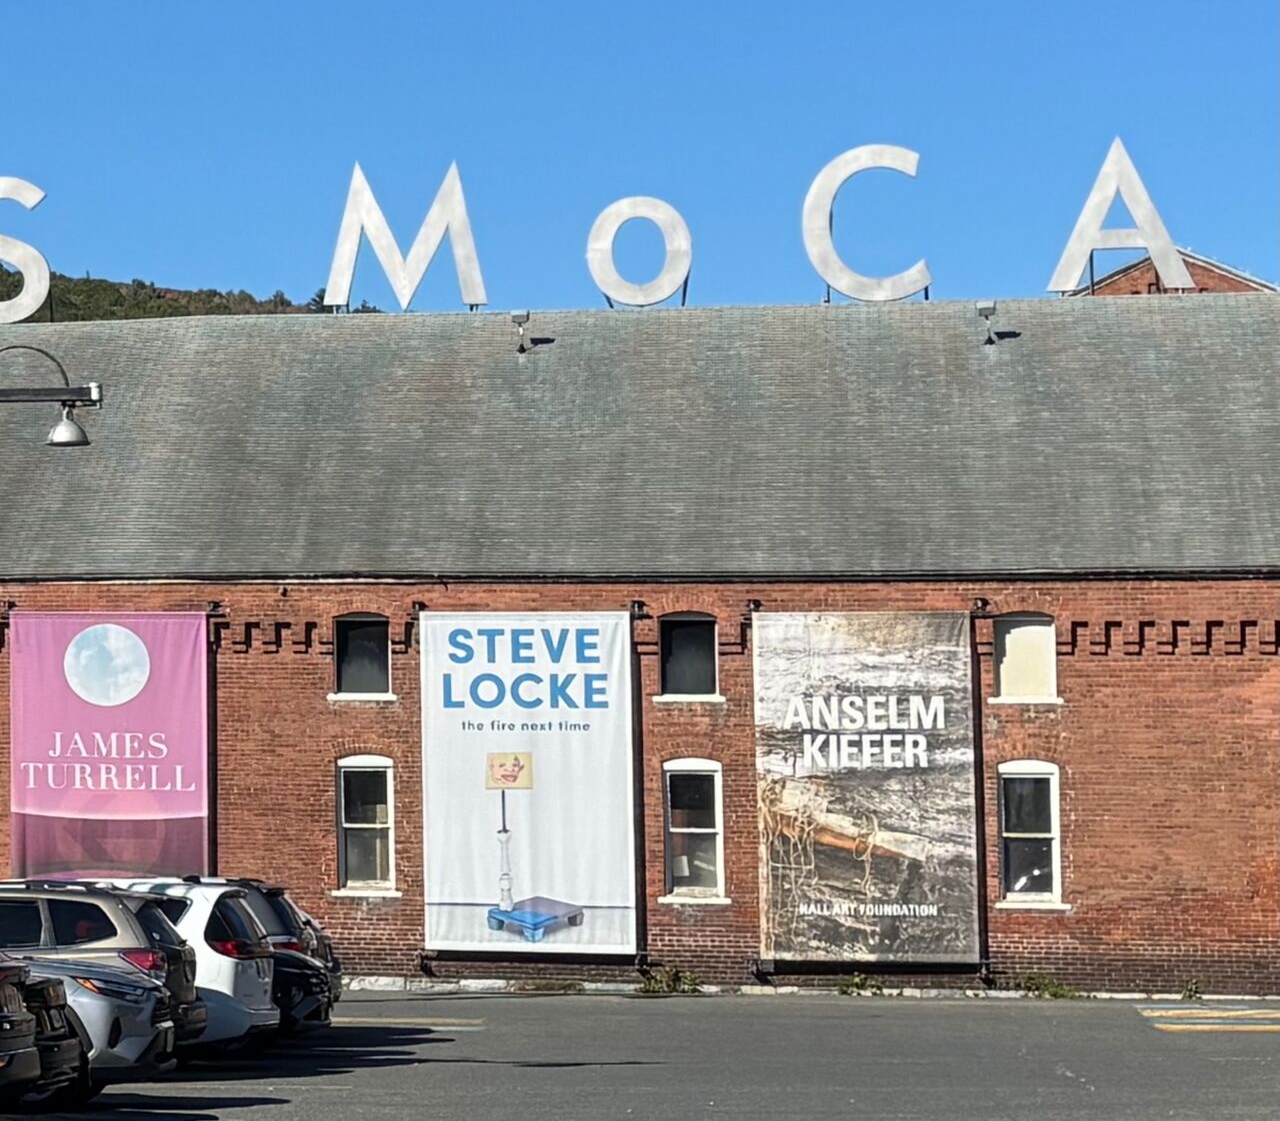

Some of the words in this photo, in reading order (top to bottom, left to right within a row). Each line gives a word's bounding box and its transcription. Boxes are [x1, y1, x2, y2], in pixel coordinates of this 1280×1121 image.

[323, 135, 1196, 311] MoCA
[448, 628, 601, 664] STEVE
[442, 673, 609, 709] LOCKE
[462, 720, 484, 731] the
[491, 720, 516, 731] fire
[521, 721, 553, 731] next
[558, 720, 591, 731] time
[783, 695, 945, 730] ANSELM
[48, 731, 168, 759] JAMES
[802, 733, 929, 768] KIEFER
[20, 762, 196, 792] TURRELL
[859, 903, 938, 917] FOUNDATION
